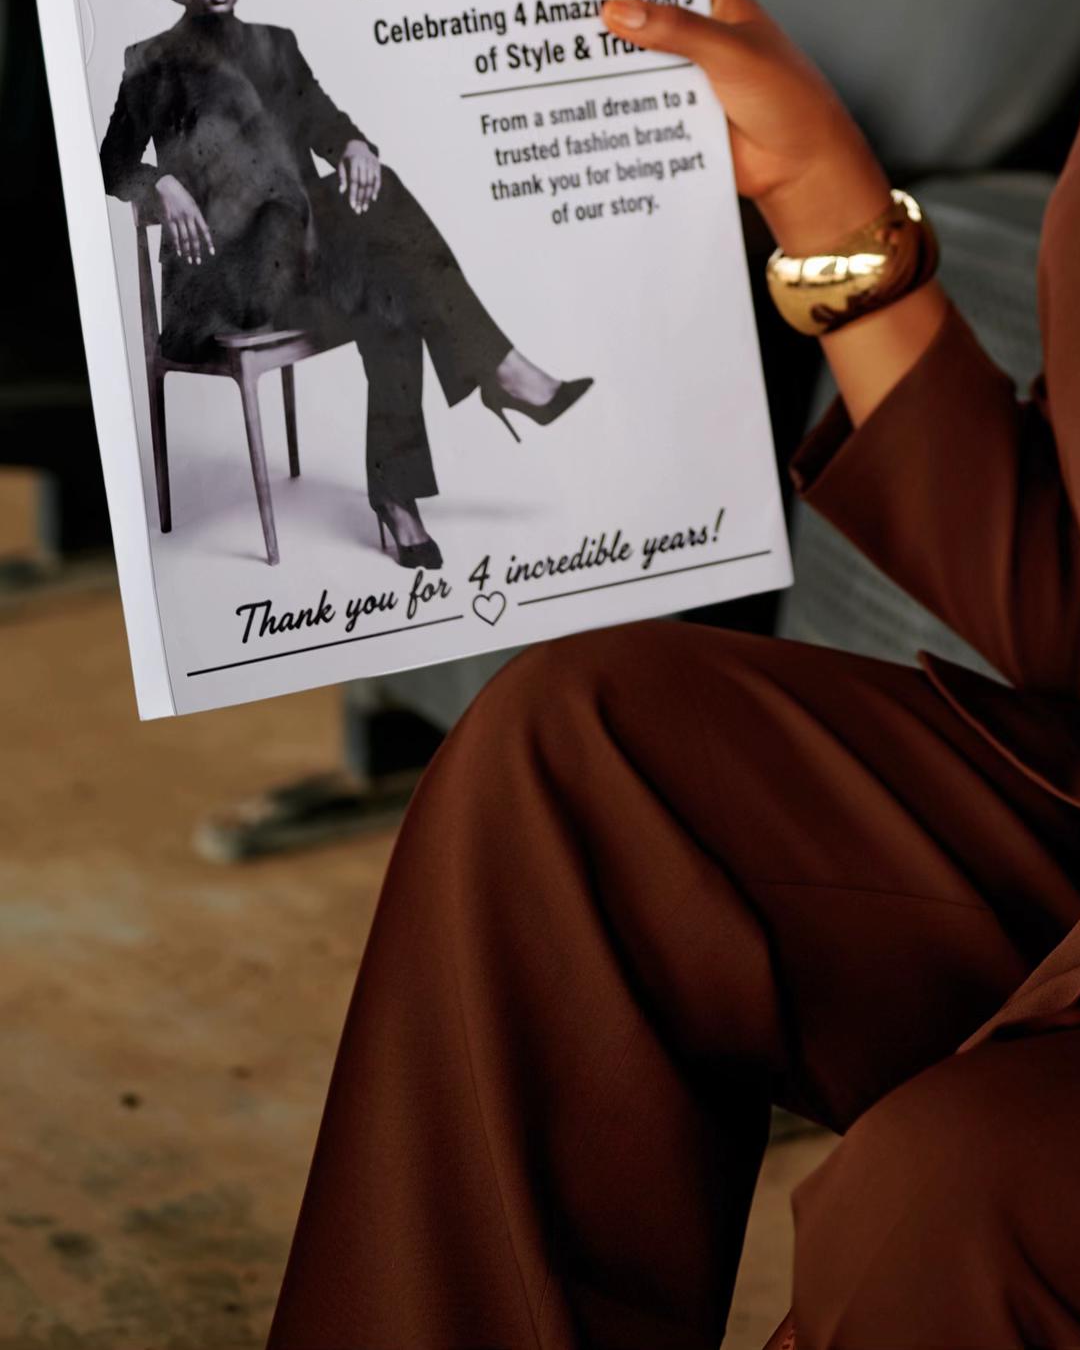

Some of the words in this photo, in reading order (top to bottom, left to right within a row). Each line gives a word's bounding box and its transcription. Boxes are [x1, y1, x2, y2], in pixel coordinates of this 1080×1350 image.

[373, 7, 507, 46] Celebrating
[514, 2, 528, 27] 4
[474, 47, 498, 74] of
[506, 39, 565, 70] Style
[573, 34, 591, 61] &
[597, 29, 648, 58] Tru
[480, 113, 529, 136] From
[533, 111, 545, 128] a
[549, 95, 597, 126] small
[602, 95, 659, 118] dream
[663, 90, 681, 109] to
[686, 90, 698, 106] a
[494, 136, 561, 167] trusted
[564, 129, 631, 156] fashion
[635, 119, 691, 148] brand,
[490, 176, 544, 201] thank
[548, 173, 582, 201] you
[585, 165, 611, 187] for
[615, 157, 665, 183] being
[669, 150, 705, 179] part
[551, 202, 570, 226] of
[575, 202, 604, 222] our
[609, 193, 660, 217] story.
[235, 589, 336, 644] Thank
[344, 591, 399, 633] you
[406, 568, 452, 620] for
[467, 554, 491, 591] 4
[504, 528, 633, 585] incredible
[641, 506, 725, 570] years!
